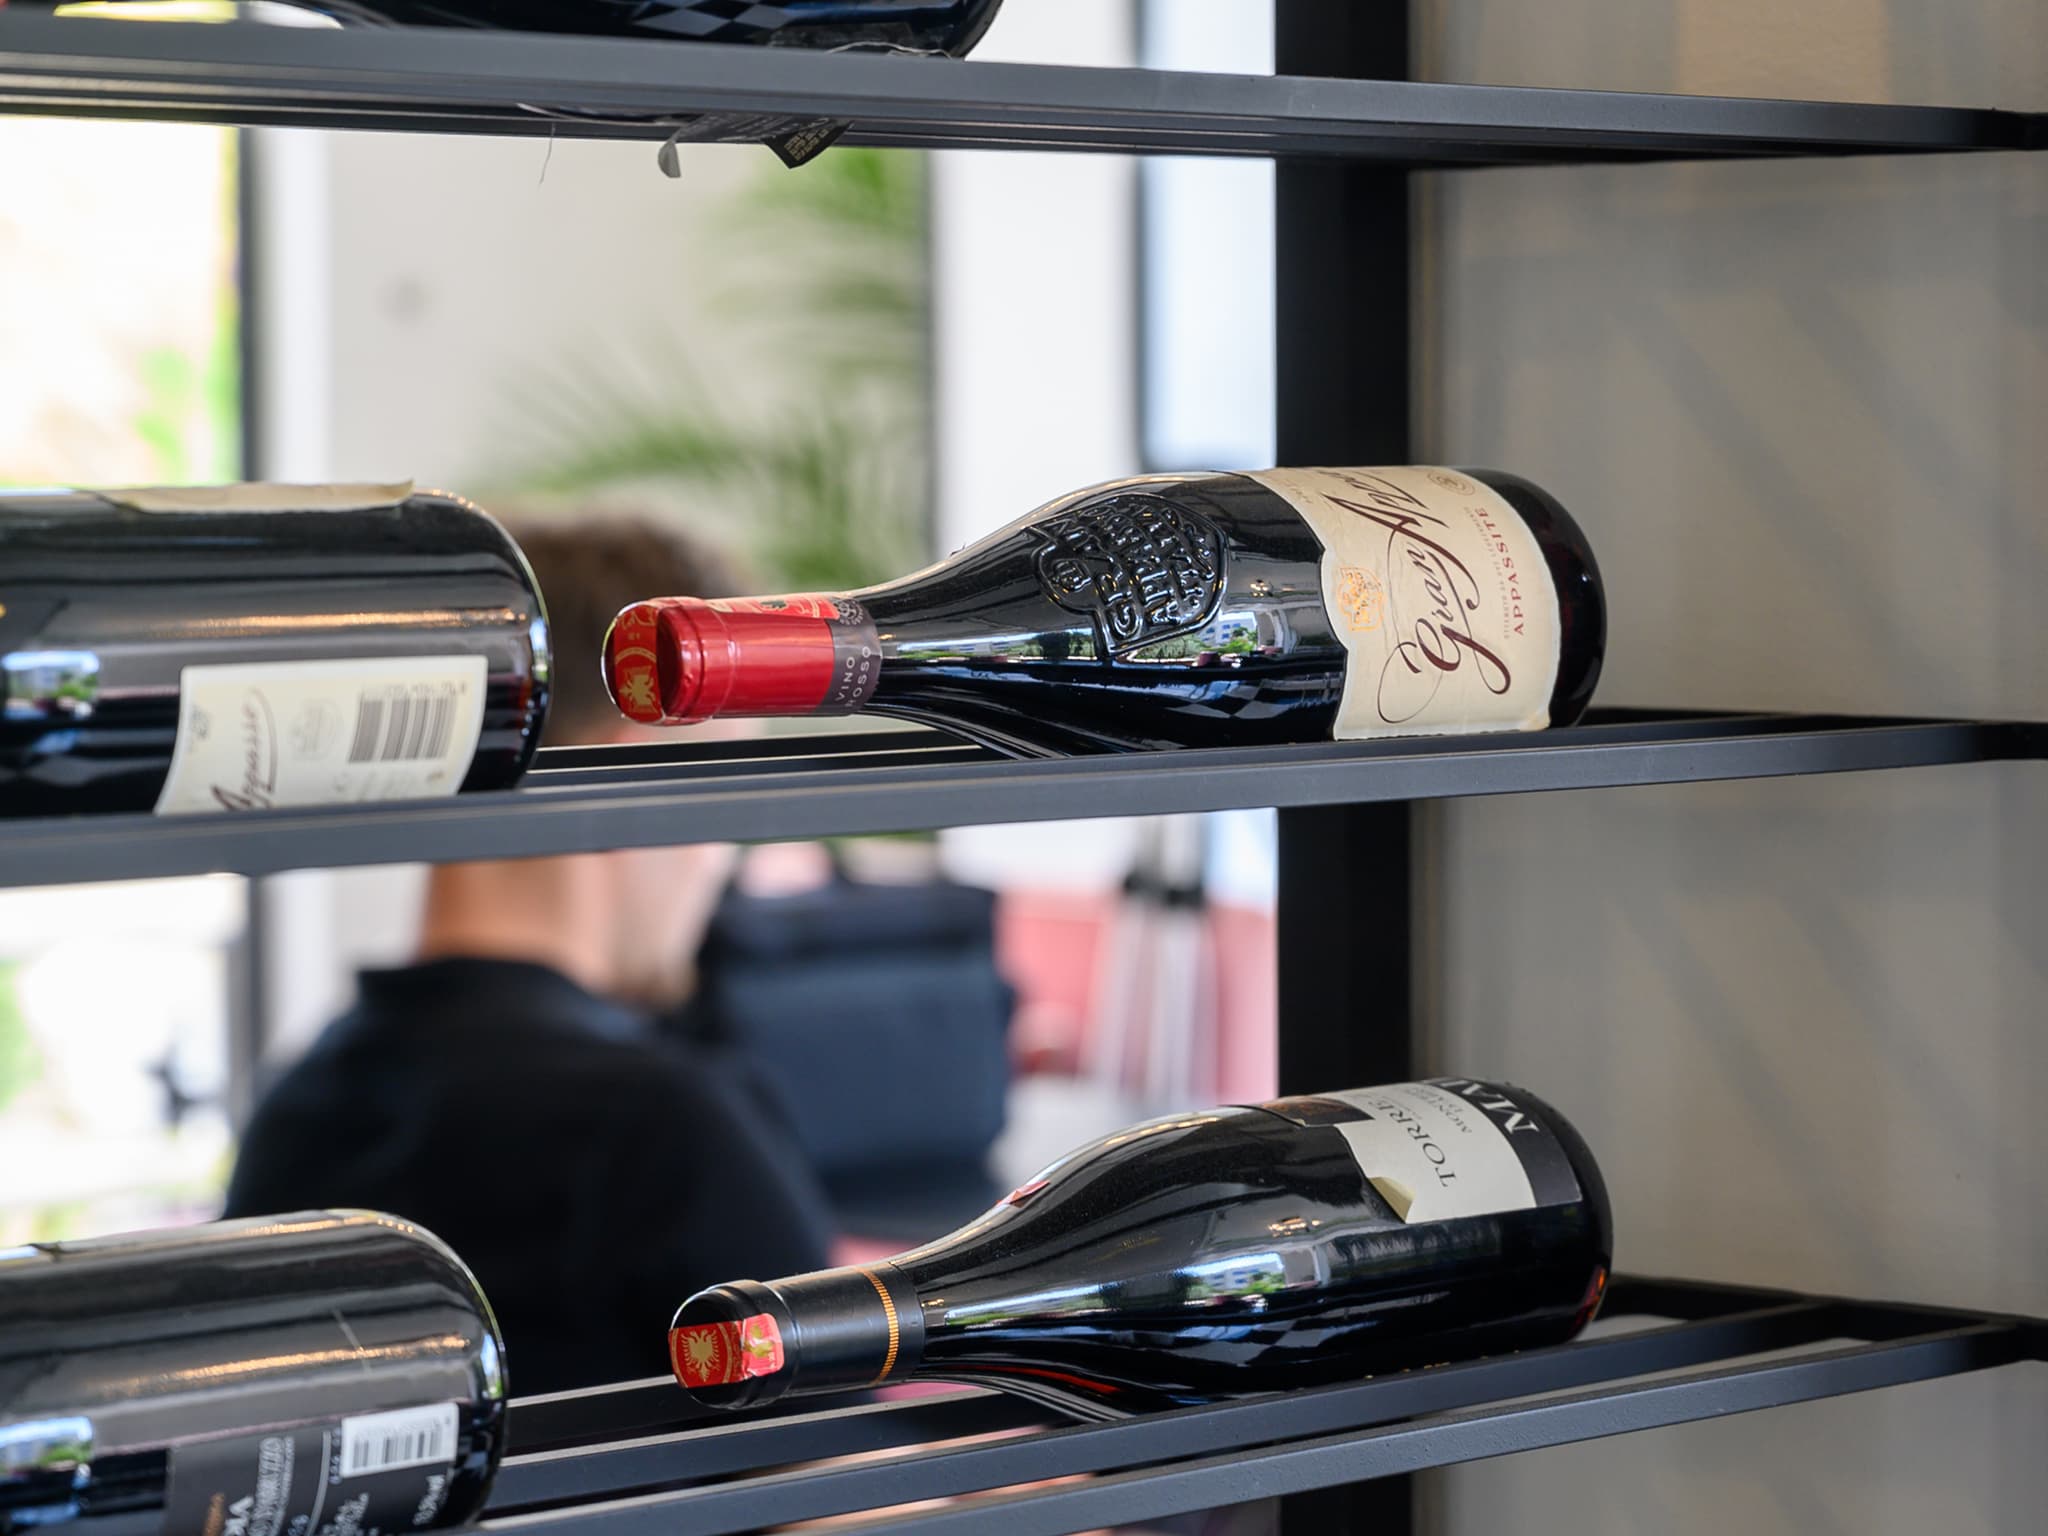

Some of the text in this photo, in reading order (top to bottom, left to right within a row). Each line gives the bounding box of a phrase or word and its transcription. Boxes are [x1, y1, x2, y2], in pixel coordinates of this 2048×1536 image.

[1379, 541, 1511, 722] Gran
[1473, 507, 1525, 636] APPASSITE
[835, 656, 856, 702] VINO
